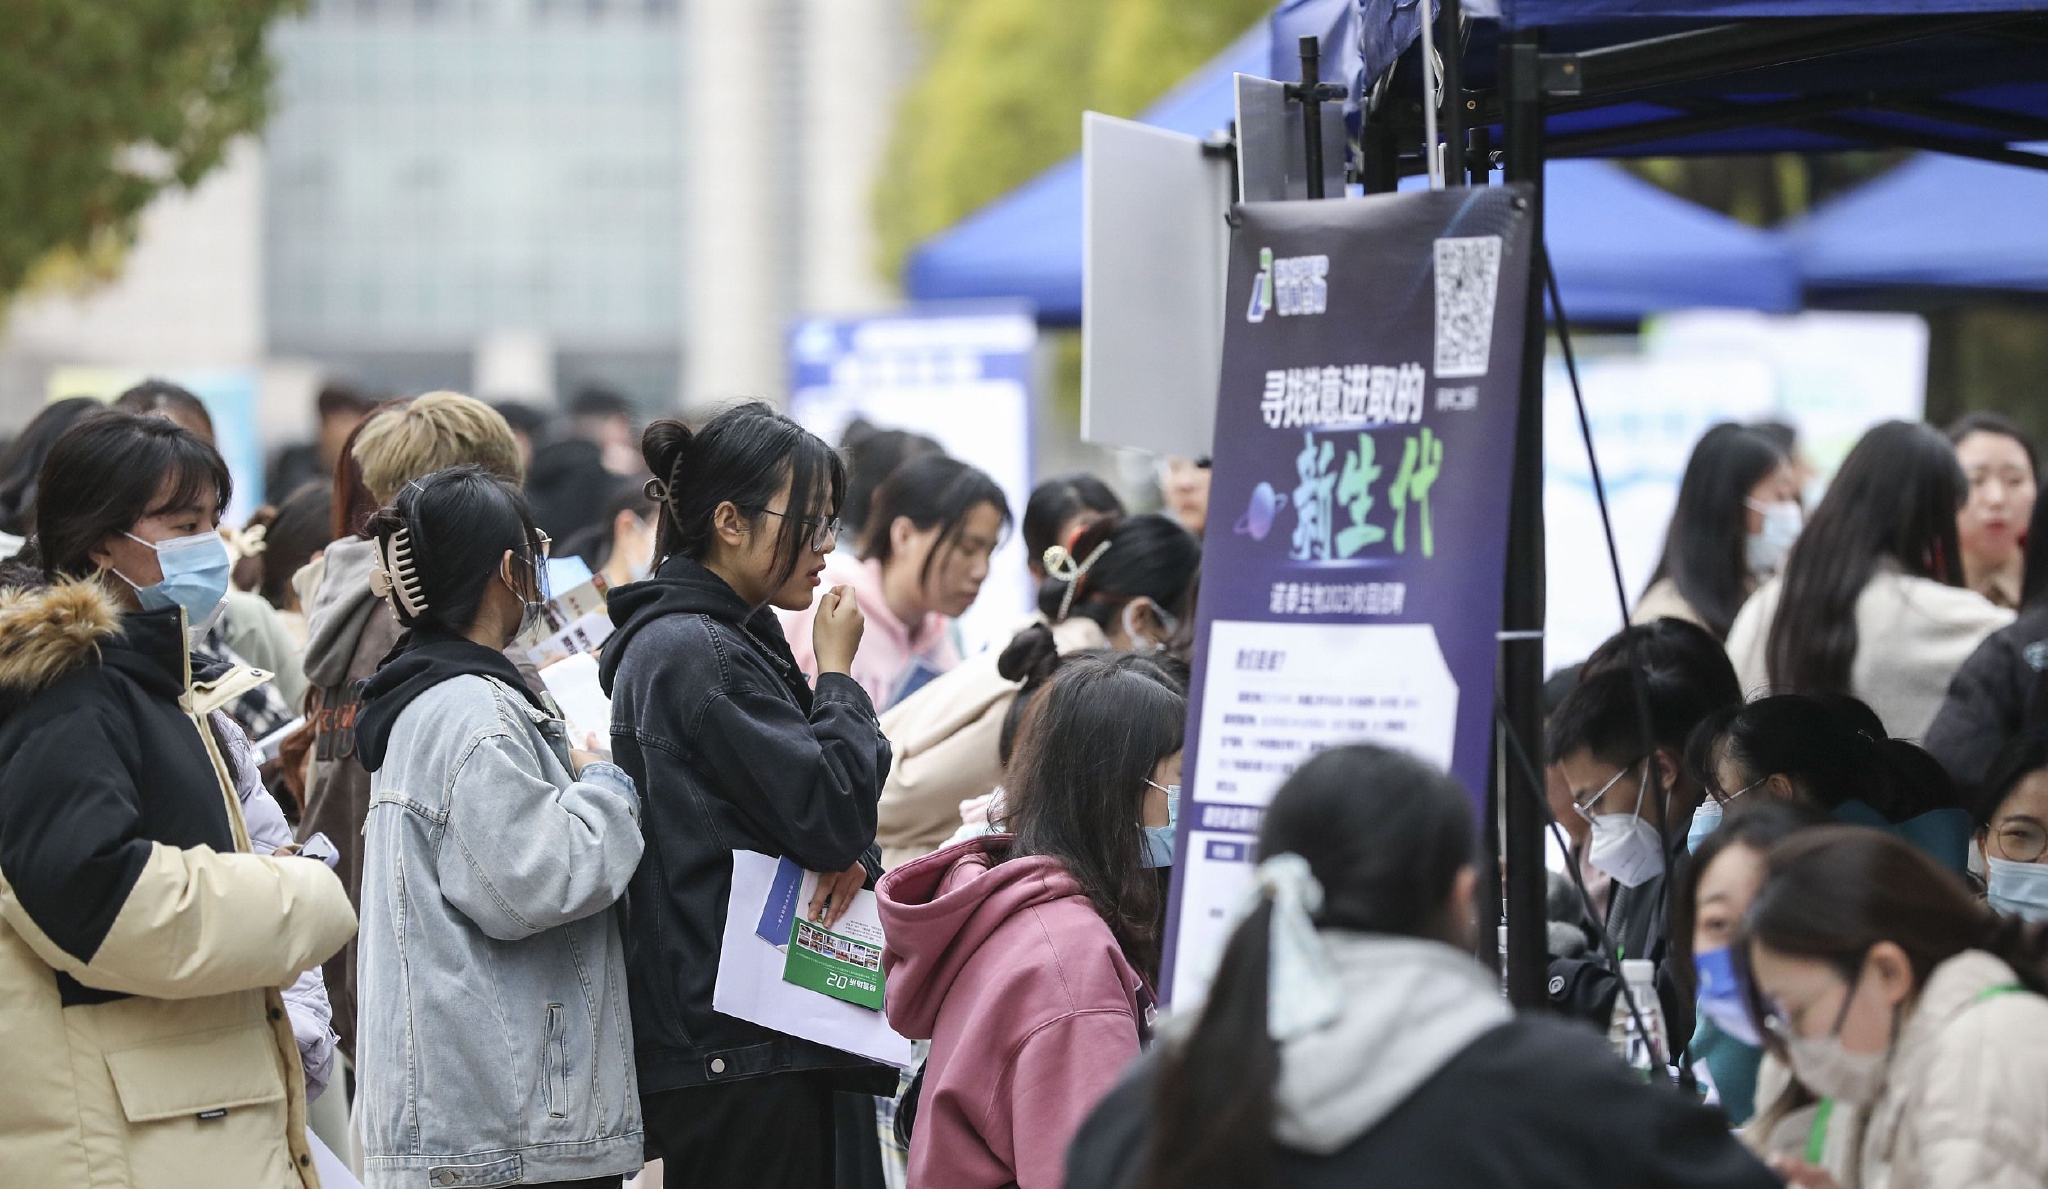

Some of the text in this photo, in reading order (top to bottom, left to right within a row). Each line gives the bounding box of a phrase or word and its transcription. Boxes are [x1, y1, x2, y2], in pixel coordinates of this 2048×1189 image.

[1290, 428, 1443, 560] 新生代
[826, 972, 848, 989] 02
